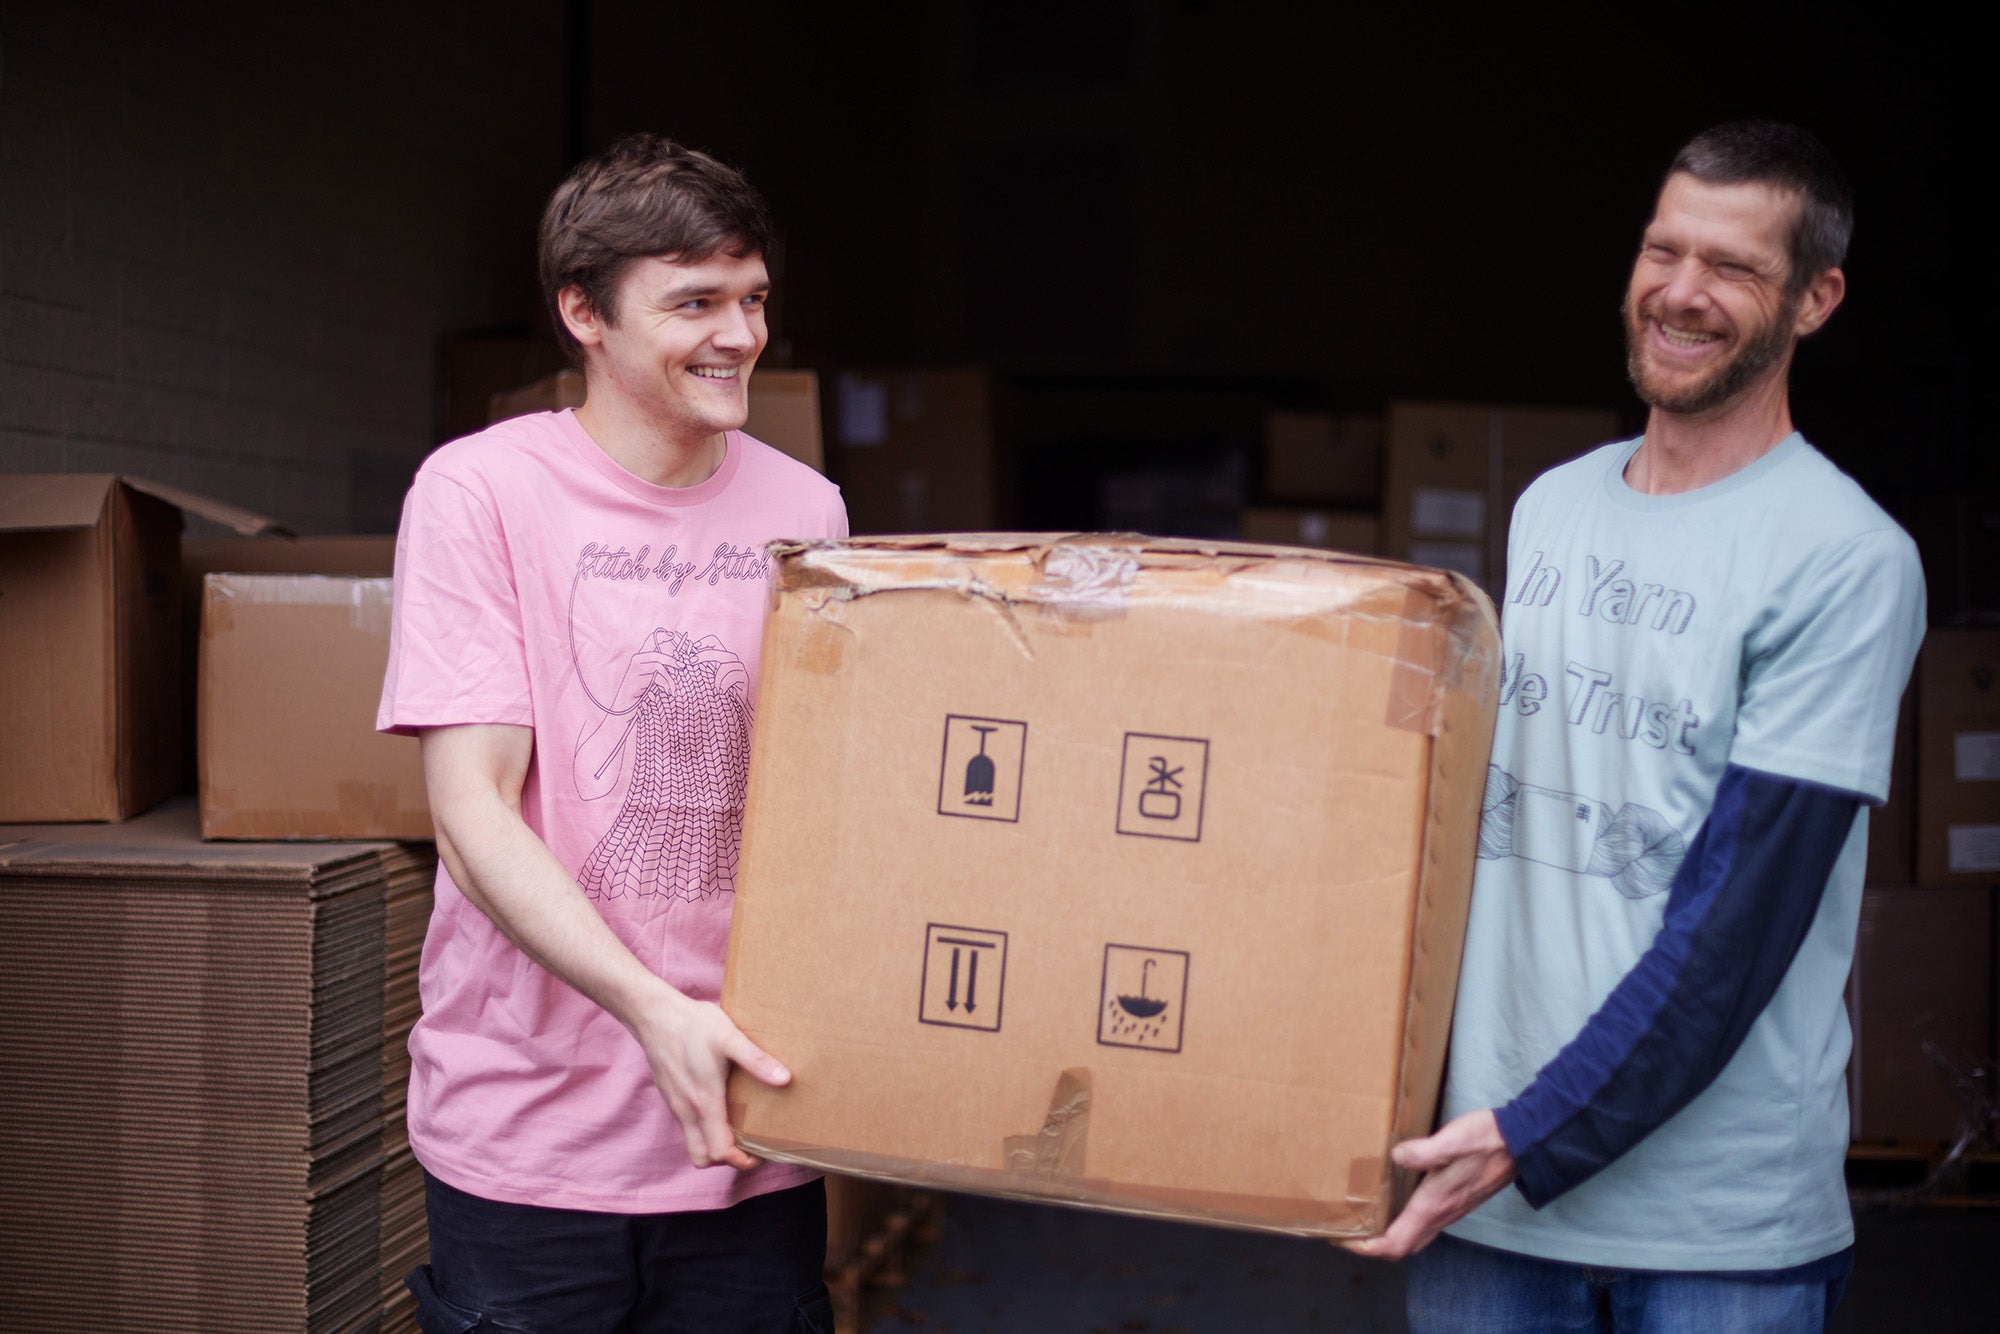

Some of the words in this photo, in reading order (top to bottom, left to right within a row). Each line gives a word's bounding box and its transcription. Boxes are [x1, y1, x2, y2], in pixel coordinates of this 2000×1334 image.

[577, 542, 649, 580] Stitch
[653, 544, 696, 597] by
[1510, 551, 1561, 606] In
[1579, 555, 1696, 635] Yarn
[1566, 661, 1699, 756] Trust
